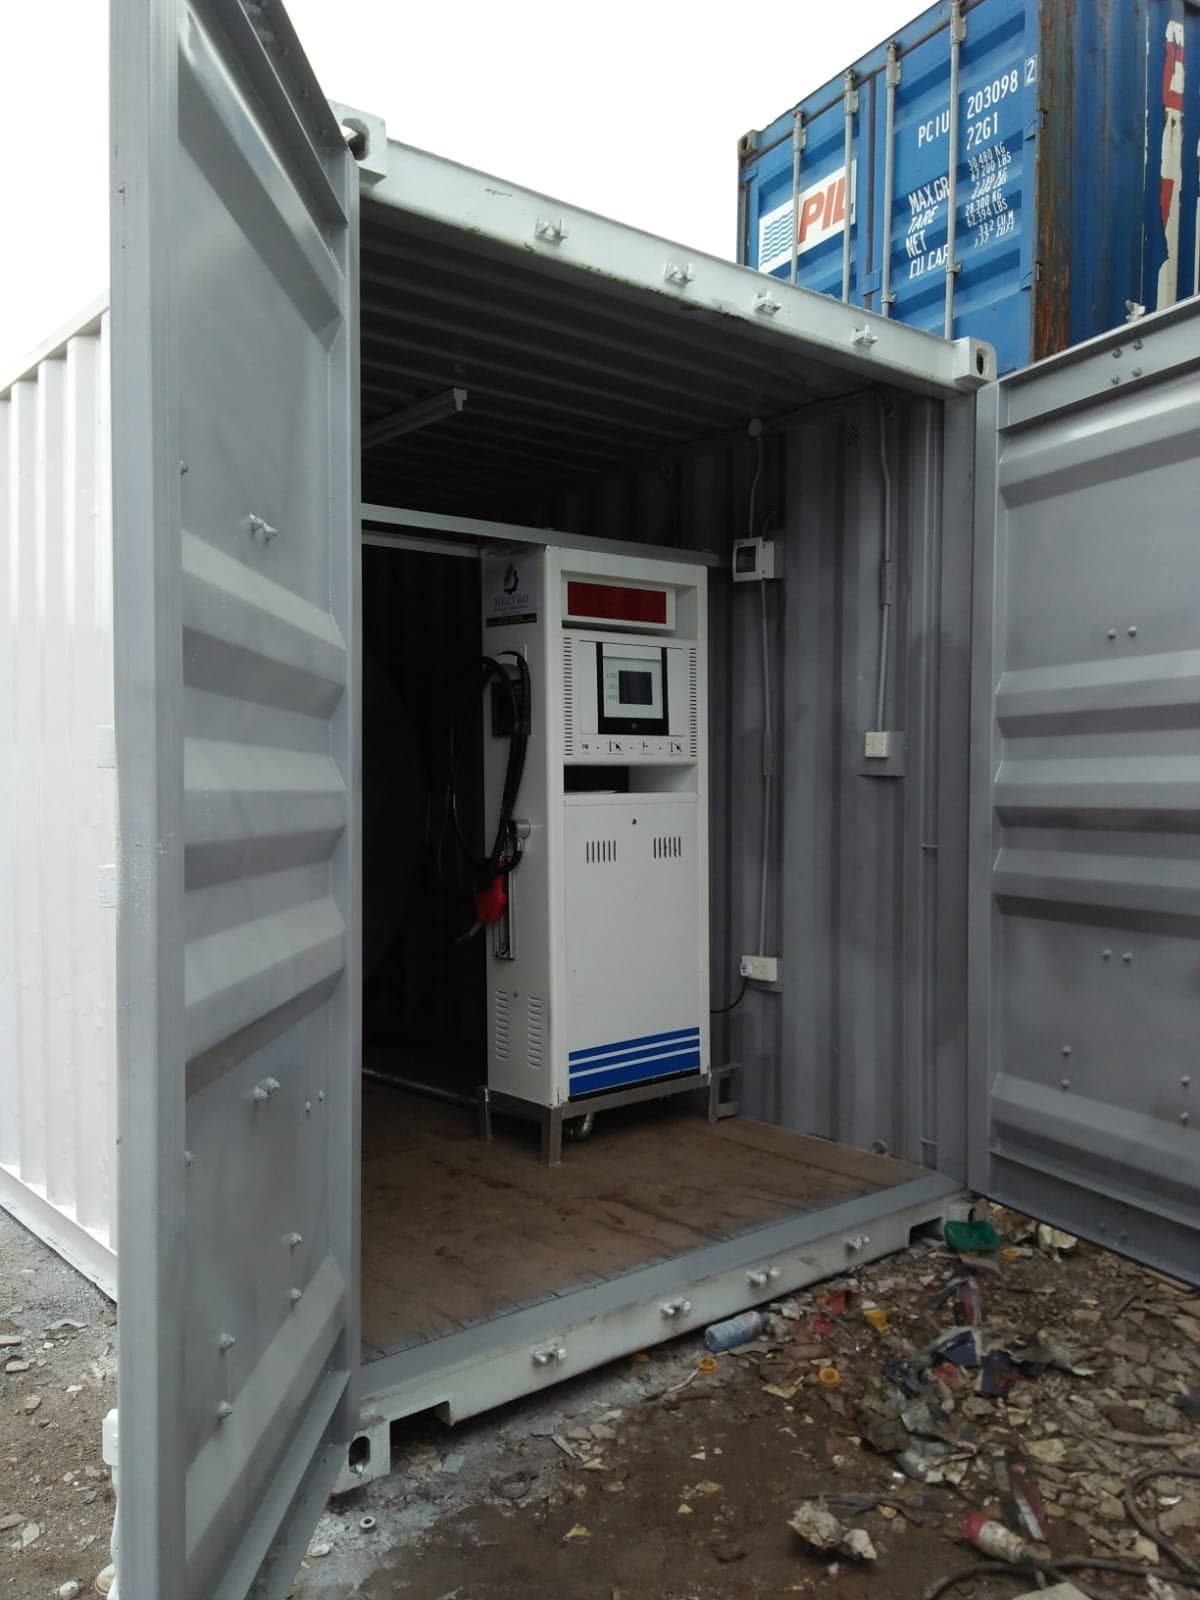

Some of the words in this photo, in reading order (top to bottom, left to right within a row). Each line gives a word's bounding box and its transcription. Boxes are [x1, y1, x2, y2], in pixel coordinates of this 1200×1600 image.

[918, 110, 950, 148] PCIU
[967, 69, 1018, 120] 203098
[1026, 58, 1036, 84] 2
[966, 111, 998, 151] 22G1
[994, 141, 1006, 156] KG
[997, 151, 1011, 168] LBS
[797, 176, 853, 245] PIL
[905, 230, 925, 258] NET
[992, 188, 1002, 203] KG
[908, 205, 938, 234] TARE
[993, 198, 1008, 214] LBS
